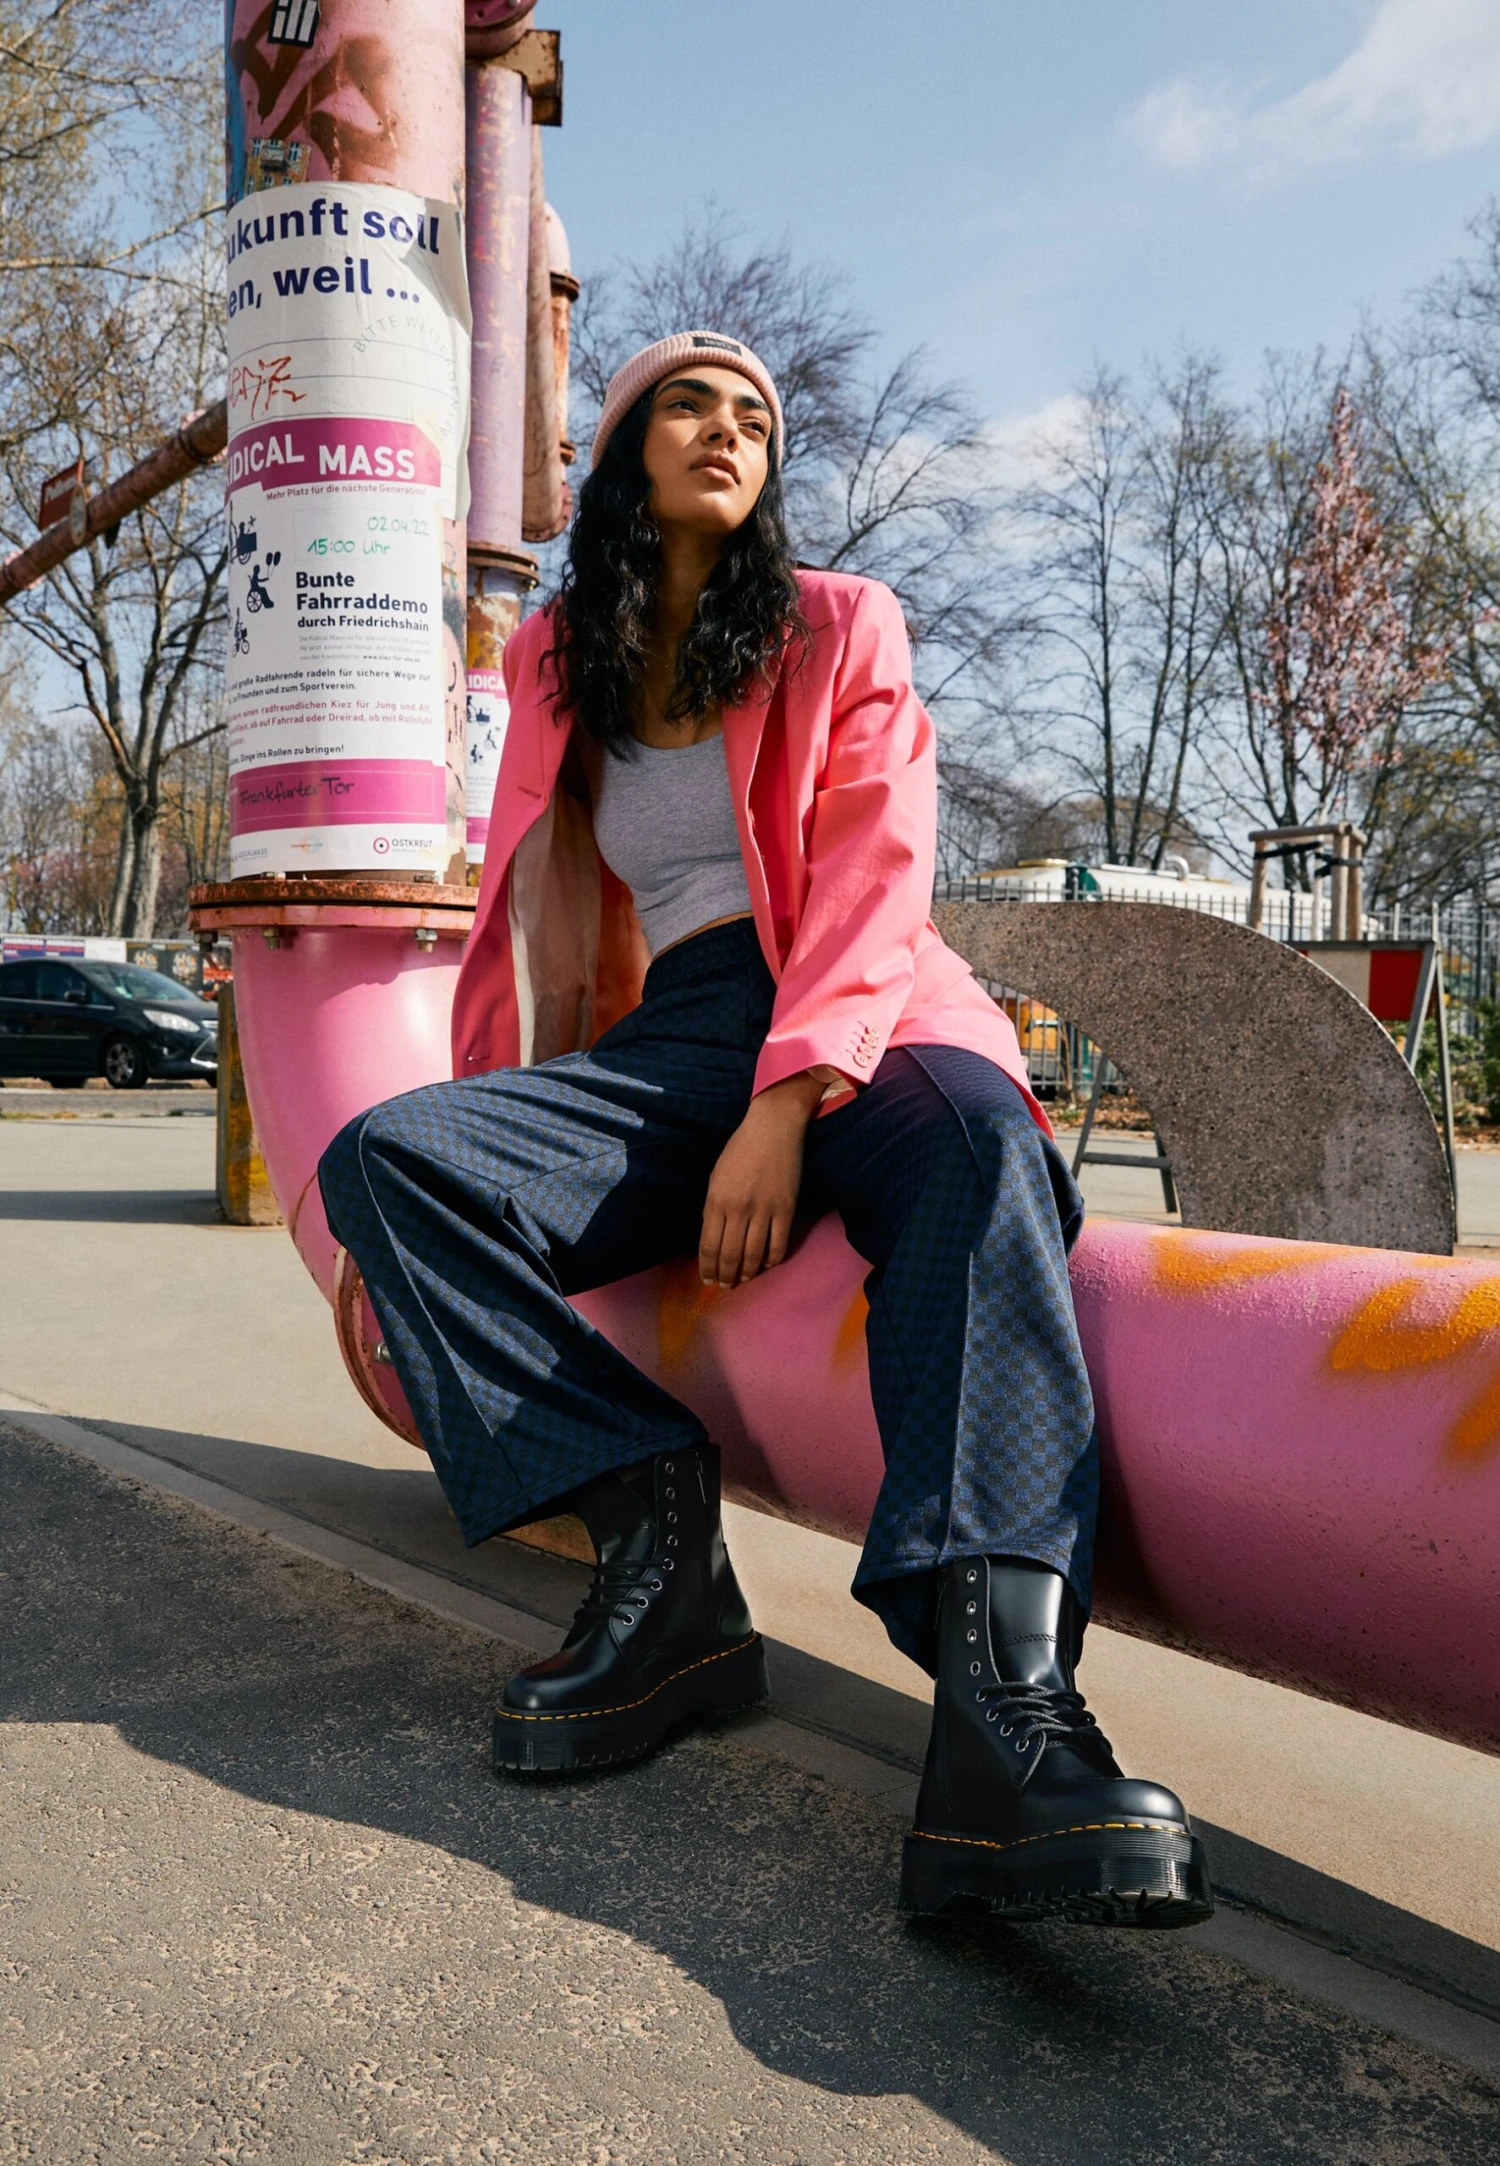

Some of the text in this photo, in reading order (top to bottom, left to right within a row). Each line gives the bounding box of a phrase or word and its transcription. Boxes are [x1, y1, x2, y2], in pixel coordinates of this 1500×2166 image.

[363, 211, 439, 254] soll
[273, 257, 372, 297] weil
[386, 288, 419, 303] ...
[353, 315, 398, 353] BITTE
[227, 434, 415, 486] IDICAL MASS
[267, 484, 427, 500] Mehr Platz für die nächste Generation!
[367, 517, 430, 536] 02.04.22
[307, 538, 391, 555] 15:00 Uhr
[296, 572, 355, 588] Bunte
[296, 593, 428, 614] Fahrraddemo
[298, 615, 429, 631] durch Friedrichshain
[255, 670, 303, 683] Radfahrende
[306, 668, 336, 677] radeln
[339, 668, 352, 677] für
[356, 669, 390, 678] sichere
[393, 670, 416, 681] Wege
[467, 674, 506, 690] IDICA
[265, 685, 279, 695] und
[281, 684, 298, 693] zum
[300, 682, 357, 693] Sportverein.
[261, 701, 327, 713] radfreundlichen
[331, 700, 352, 709] Kiez
[356, 700, 369, 709] für
[374, 700, 396, 712] Jung
[400, 703, 416, 711] und
[259, 717, 270, 727] auf
[272, 714, 304, 726] Fahrrad
[305, 713, 326, 722] oder
[329, 713, 366, 722] Dreirad,
[369, 714, 380, 722] ob
[382, 714, 396, 722] mit
[398, 714, 432, 725] Rollstuhl
[256, 750, 267, 759] ins
[268, 747, 292, 757] Rollen
[294, 747, 304, 755] zu
[305, 745, 344, 756] bringen!
[321, 777, 354, 795] Tor
